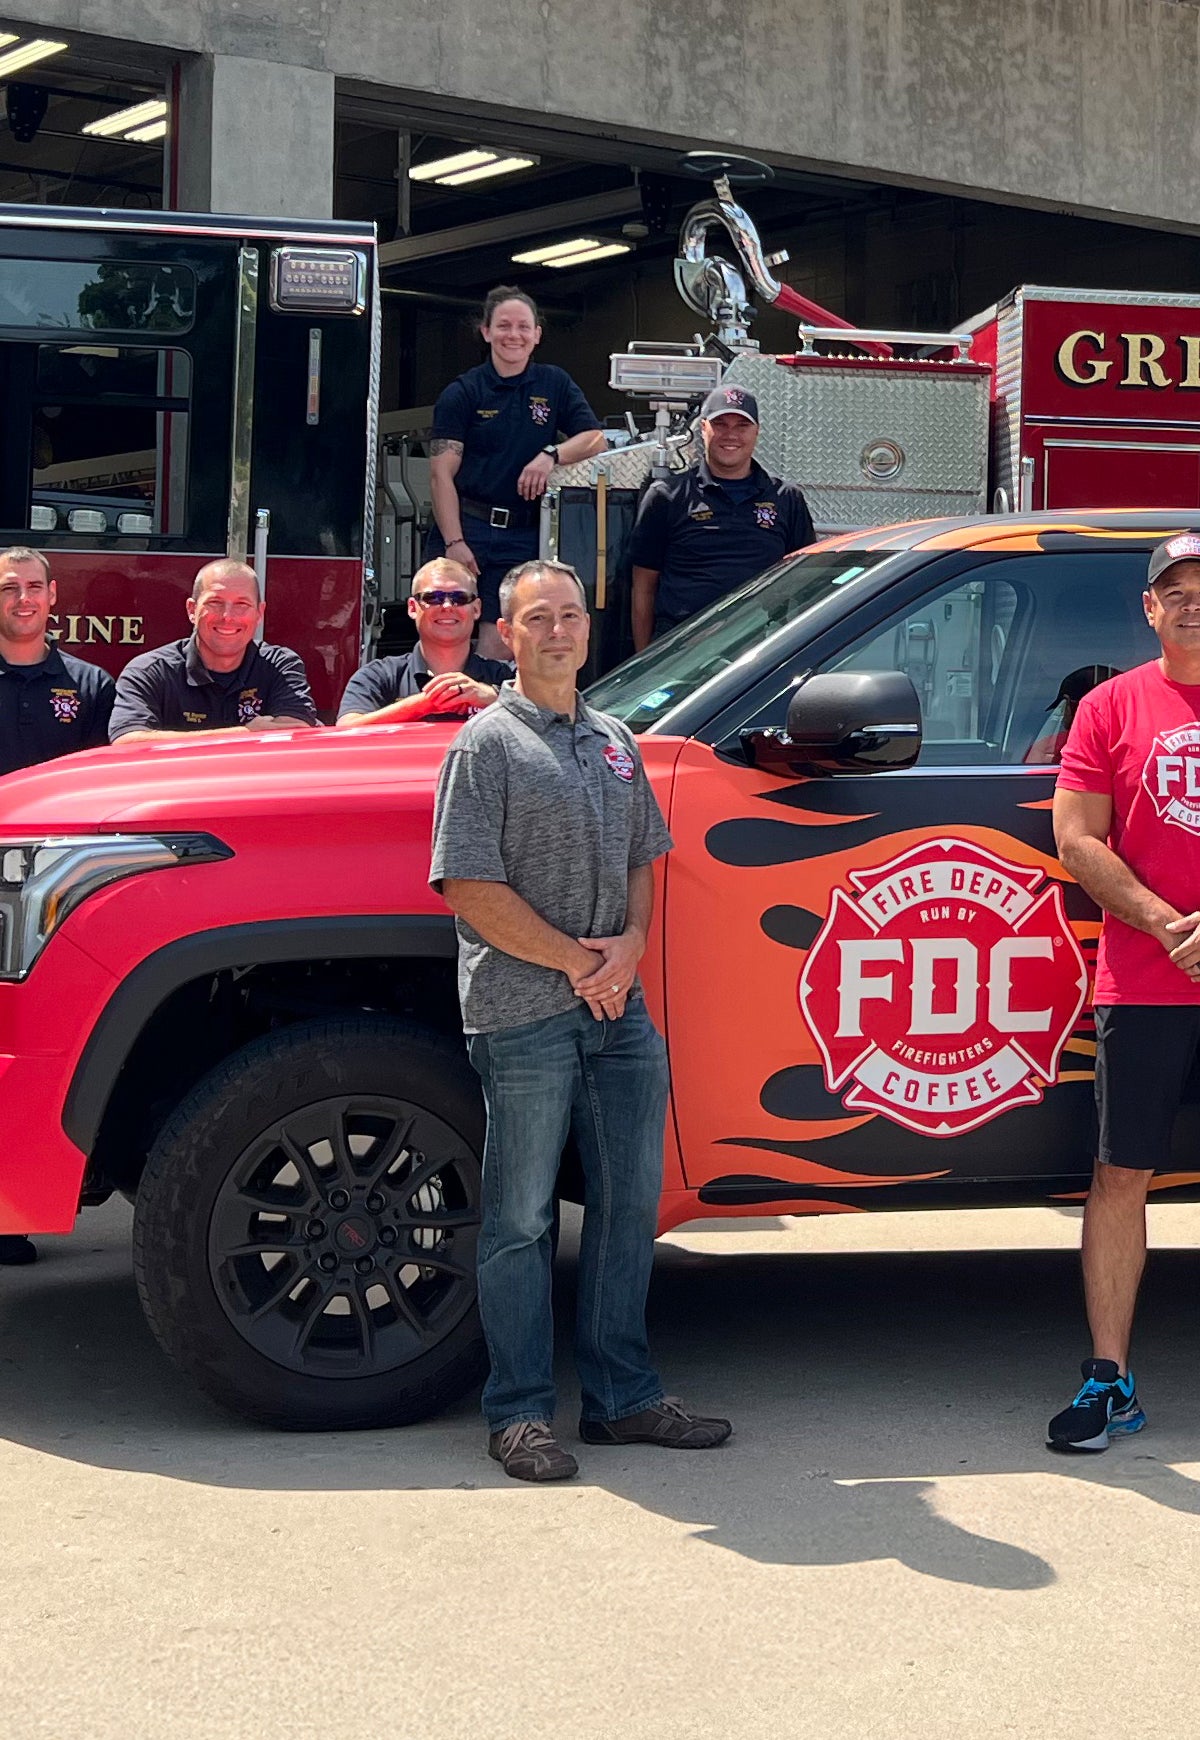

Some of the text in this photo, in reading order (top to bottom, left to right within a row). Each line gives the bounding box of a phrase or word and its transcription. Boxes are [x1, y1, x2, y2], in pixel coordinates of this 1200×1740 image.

[1169, 732, 1193, 748] FIRE
[871, 868, 1020, 915] FIRE DEPT.
[919, 906, 977, 923] RUN BY
[891, 1037, 994, 1066] FIREFIGHTERS
[882, 1068, 1002, 1106] COFFEE
